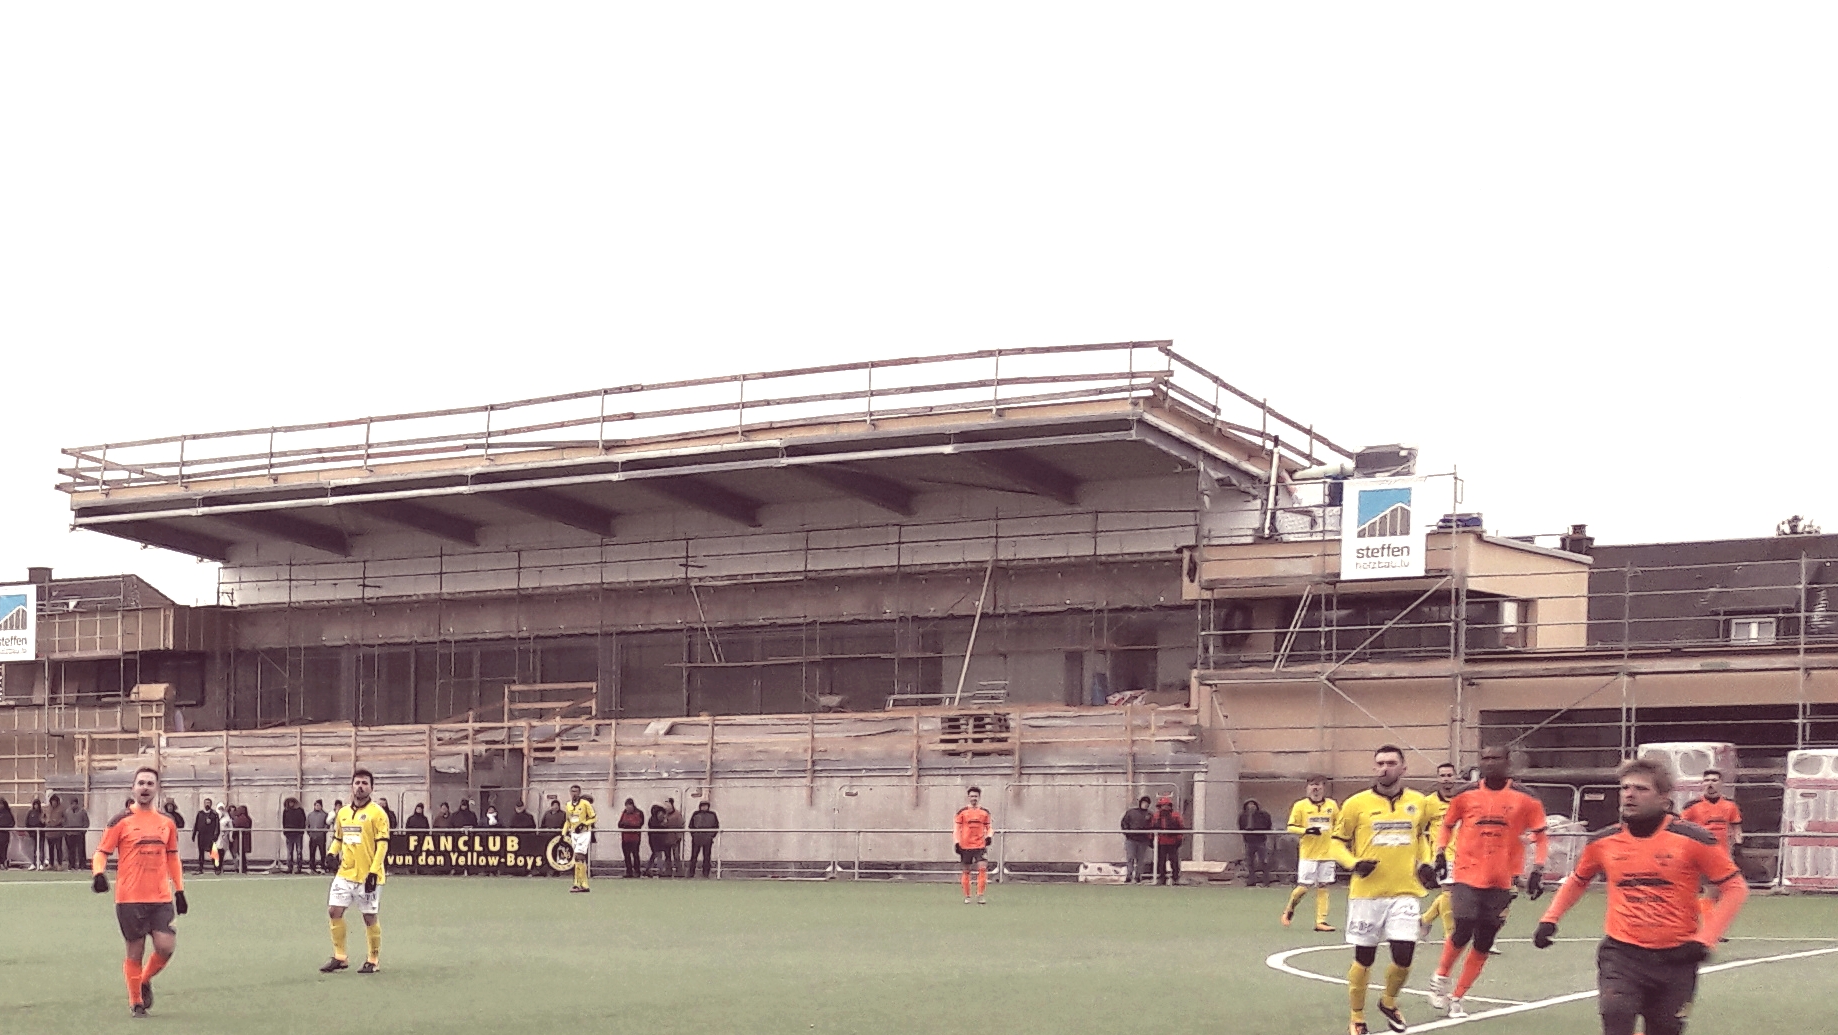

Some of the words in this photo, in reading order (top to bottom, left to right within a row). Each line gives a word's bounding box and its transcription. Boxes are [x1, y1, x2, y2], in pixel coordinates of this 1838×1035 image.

[1356, 543, 1410, 558] steffen
[408, 835, 520, 851] FANCLUB
[417, 852, 445, 866] den
[450, 851, 543, 870] Yellow-Boys
